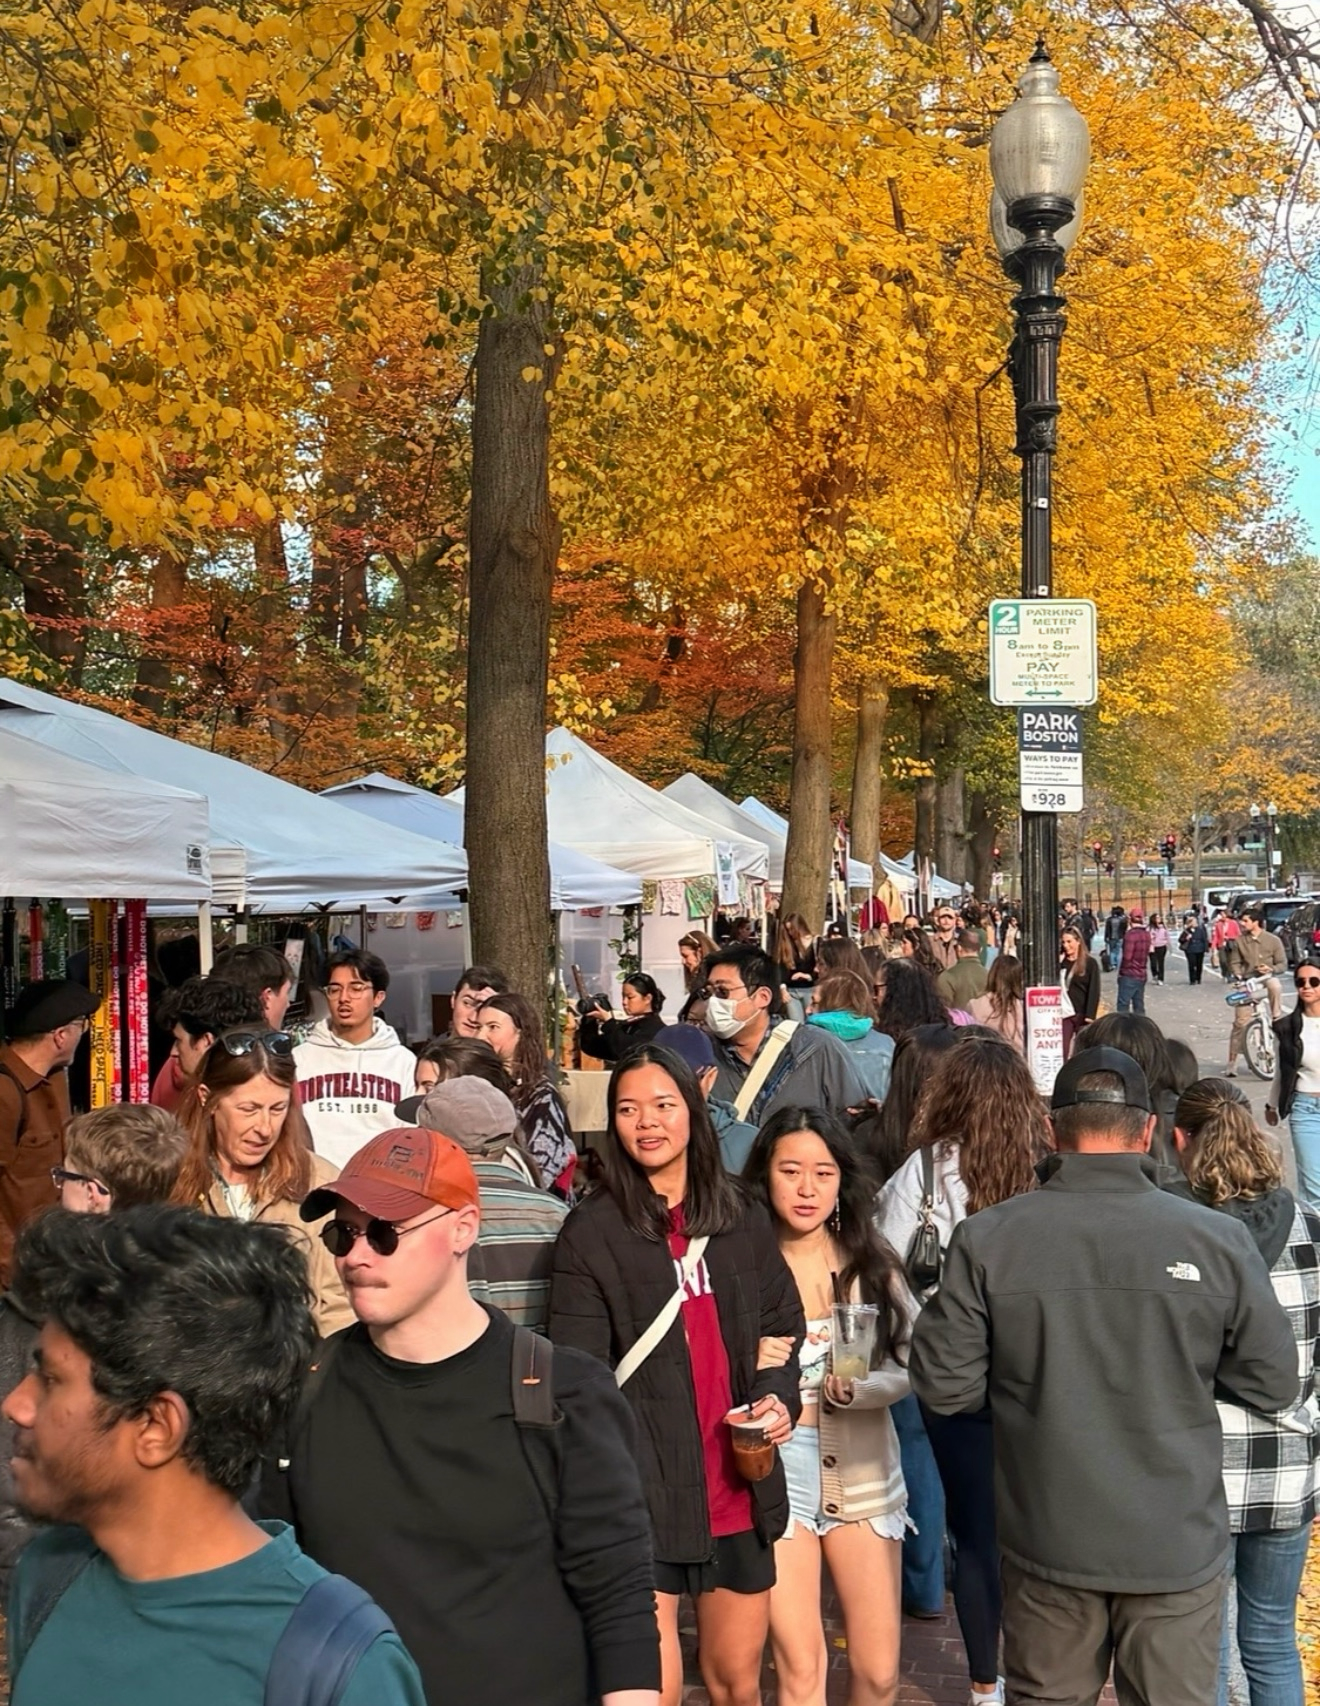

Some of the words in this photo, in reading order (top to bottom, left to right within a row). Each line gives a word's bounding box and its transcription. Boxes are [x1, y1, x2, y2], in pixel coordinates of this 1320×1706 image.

[997, 606, 1017, 626] 2
[1033, 618, 1077, 626] METER
[1007, 639, 1035, 650] 8am
[1053, 640, 1080, 651] 8pm
[1027, 662, 1060, 672] PAY
[1023, 712, 1078, 731] PARK
[1023, 730, 1079, 743] BOSTON
[1023, 754, 1048, 762] WAYS
[1049, 755, 1061, 763] TO
[1062, 755, 1079, 763] PAY
[1038, 792, 1066, 806] 928
[1036, 1040, 1063, 1050] ANY
[319, 1102, 345, 1113] EST.
